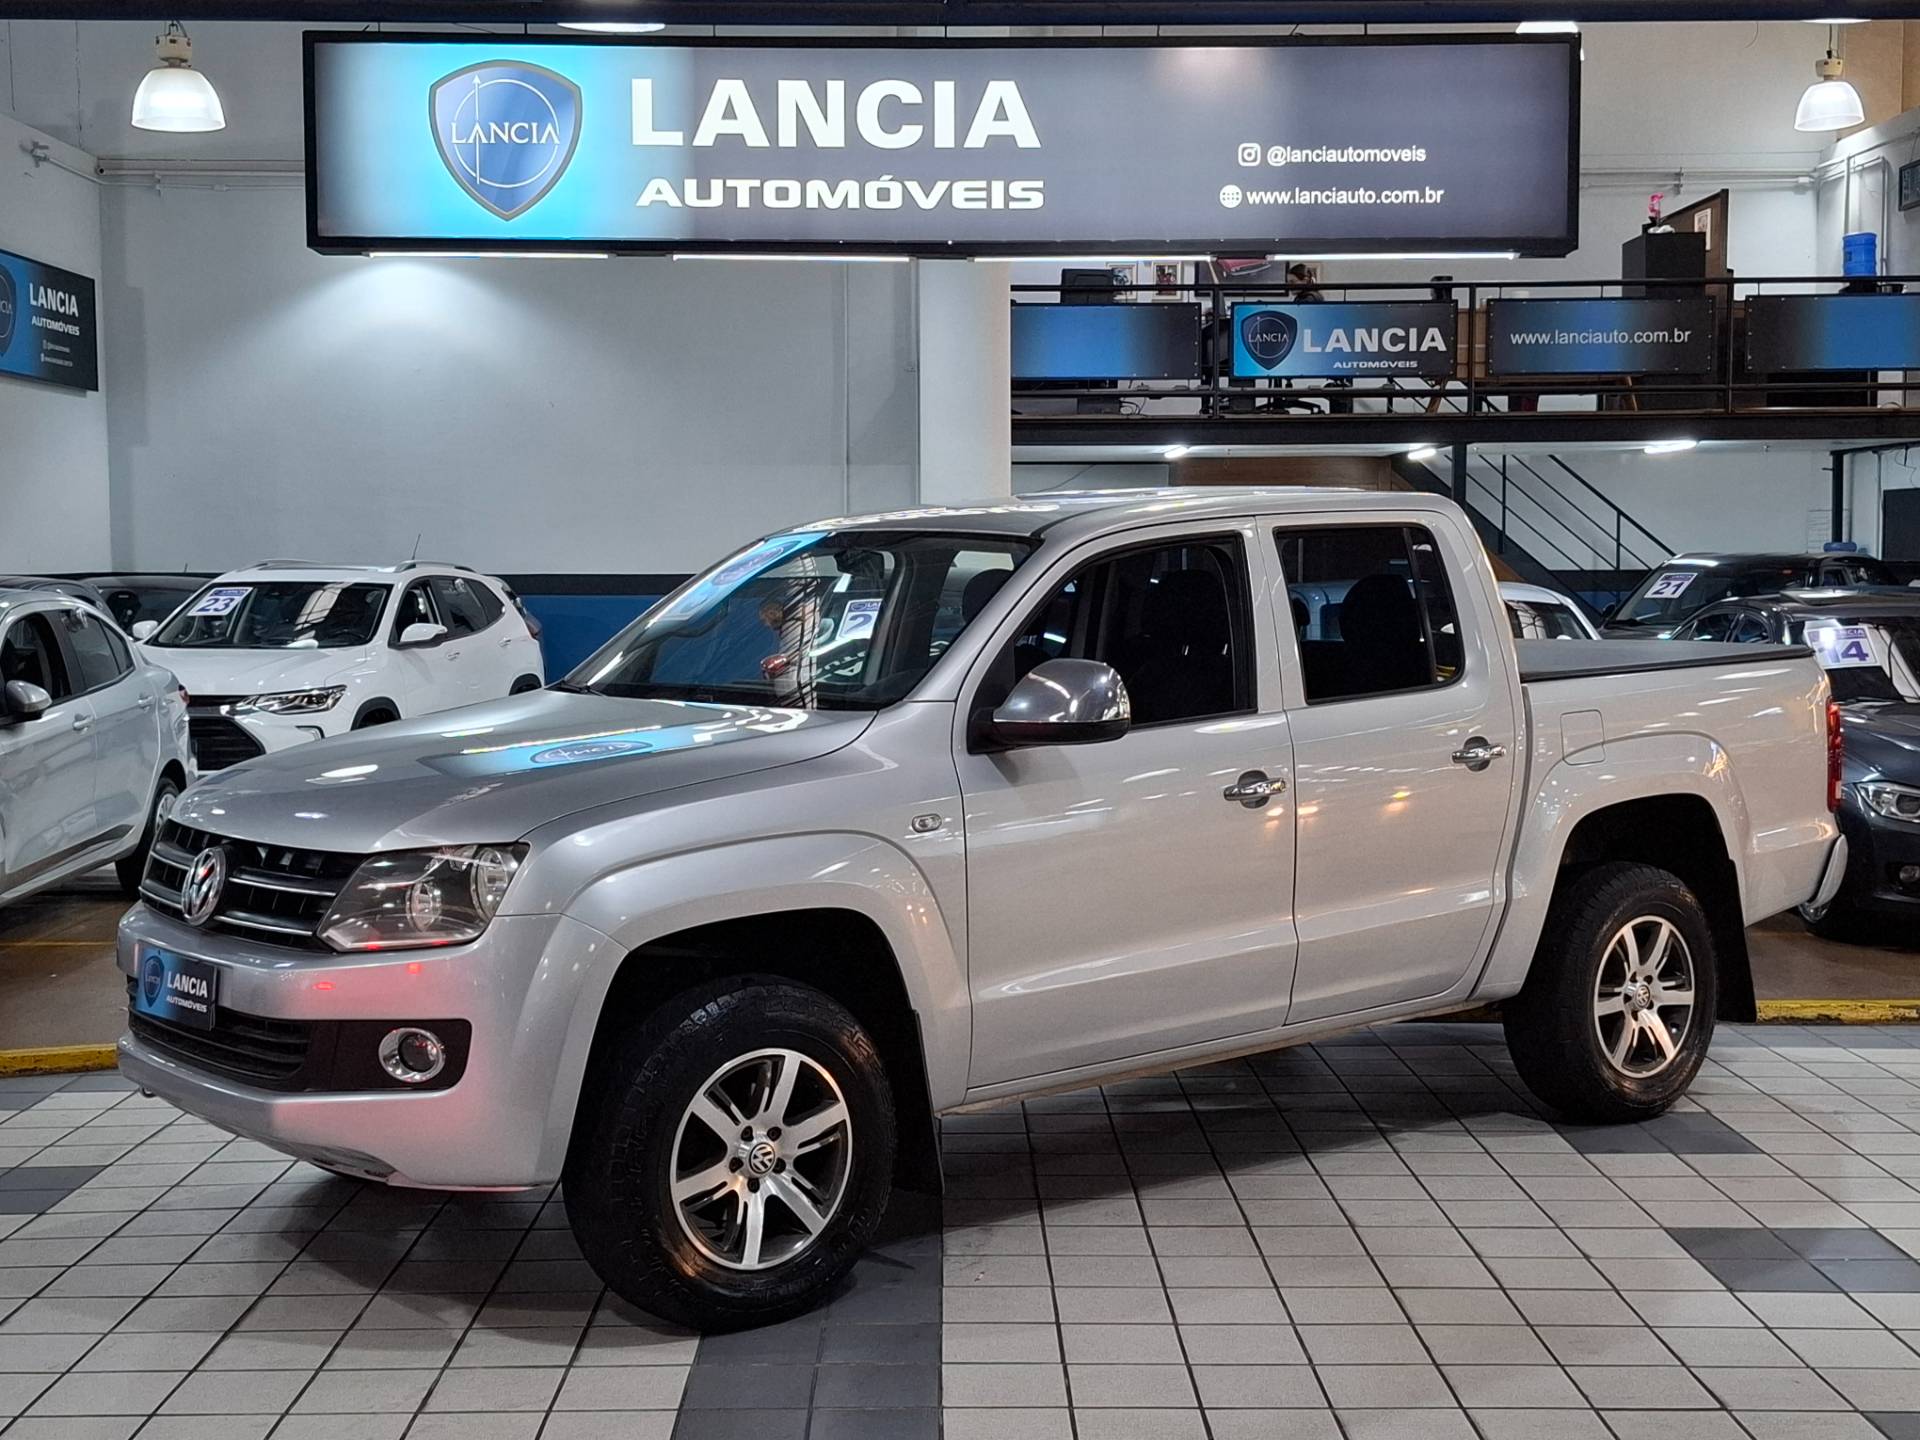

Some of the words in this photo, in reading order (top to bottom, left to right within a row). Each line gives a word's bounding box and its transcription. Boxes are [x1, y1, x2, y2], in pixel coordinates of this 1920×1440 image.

[631, 78, 1042, 149] LANCIA
[451, 121, 560, 144] LANCIA
[1267, 145, 1426, 166] @lanciautomoveis
[636, 174, 1044, 211] AUTOMÓVEIS
[1246, 186, 1444, 206] www.lanciauto.com.br
[29, 282, 79, 317] LANCIA
[31, 315, 80, 336] AUTOMÓVEIS
[1248, 333, 1290, 344] LANCIA
[1303, 326, 1447, 353] LANCIA
[1510, 329, 1691, 345] www.lanciauto.com.br
[1333, 360, 1418, 369] AUTOMÓVEIS
[1651, 581, 1685, 596] 21
[196, 597, 236, 612] 23
[167, 971, 208, 998] LANCIA
[166, 994, 208, 1013] AUTOMÓVEIS
